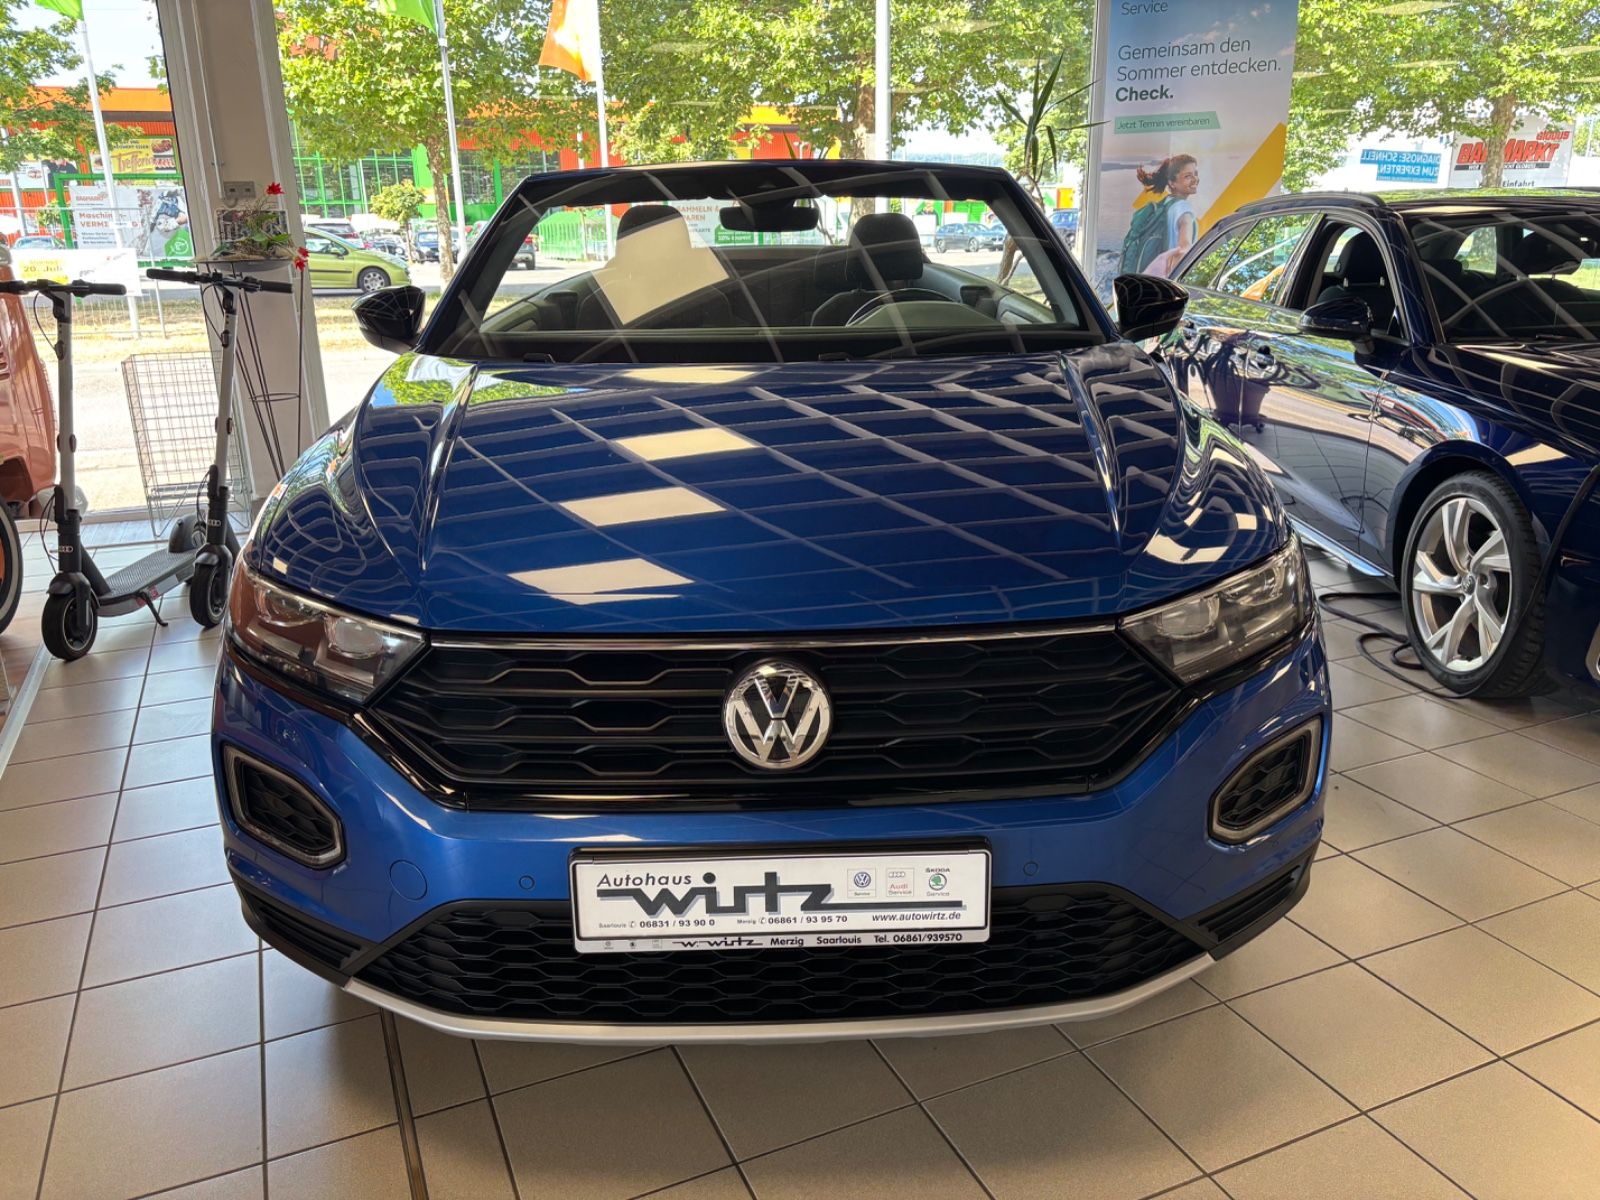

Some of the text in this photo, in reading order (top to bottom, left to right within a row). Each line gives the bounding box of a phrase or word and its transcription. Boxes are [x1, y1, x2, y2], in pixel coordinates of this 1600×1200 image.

[1121, 1, 1168, 15] Service
[1117, 37, 1251, 61] Gemeinsam den
[1116, 57, 1281, 81] Sommer entdecken.
[1115, 84, 1174, 102] Check.
[1117, 117, 1210, 130] Jetzt Termin vereinbaren
[597, 872, 692, 887] Autohaus
[767, 916, 797, 924] 06861
[820, 915, 833, 923] 95
[872, 911, 961, 921] www.autowirtz.de
[639, 920, 669, 928] 06831
[678, 919, 691, 928] 93
[770, 936, 804, 948] Merzig
[816, 935, 862, 944] Saarlouis
[874, 934, 889, 943] Tel.
[893, 932, 963, 943] 06861/939570
